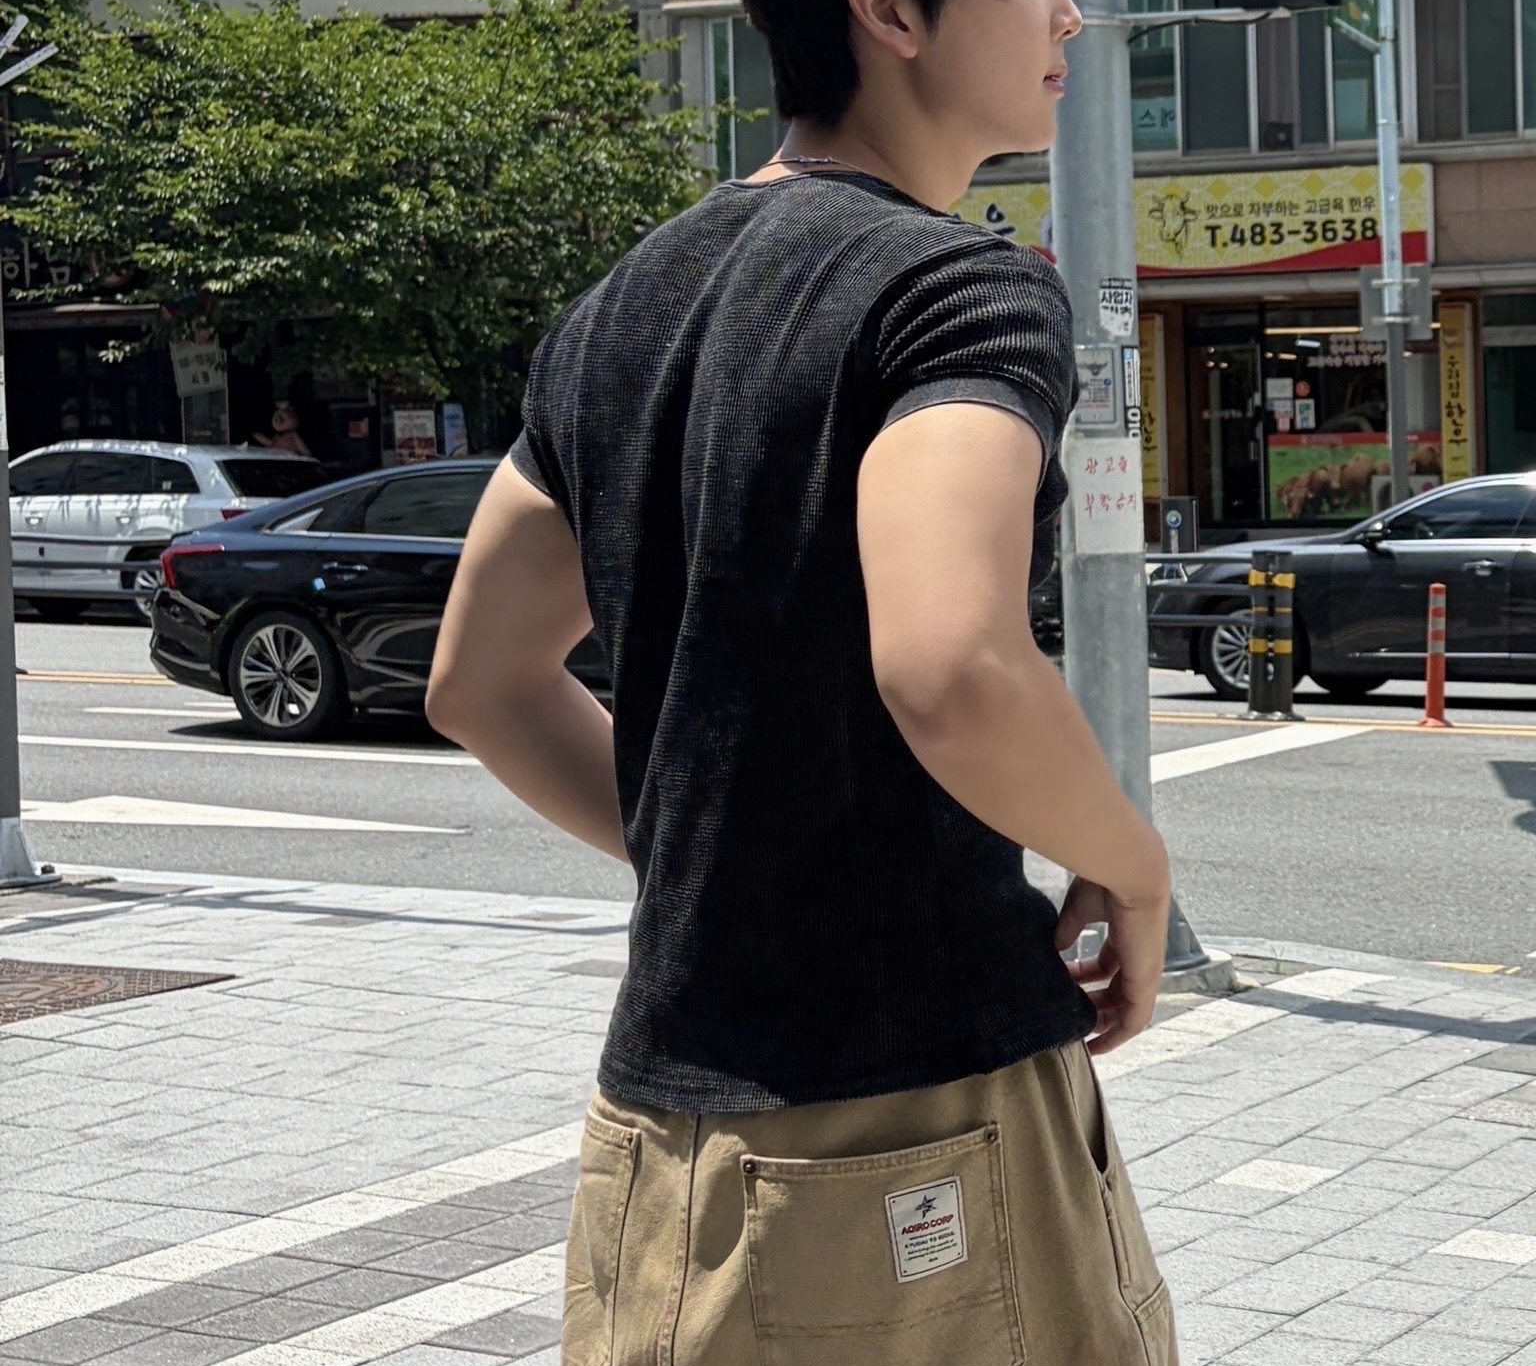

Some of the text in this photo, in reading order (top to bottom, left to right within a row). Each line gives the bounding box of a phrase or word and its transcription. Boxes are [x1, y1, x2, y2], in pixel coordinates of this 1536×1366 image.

[1206, 202, 1244, 219] 맛으로
[1249, 200, 1300, 217] 자부하는
[1349, 196, 1376, 213] 한우
[1205, 217, 1378, 248] T.483-3638
